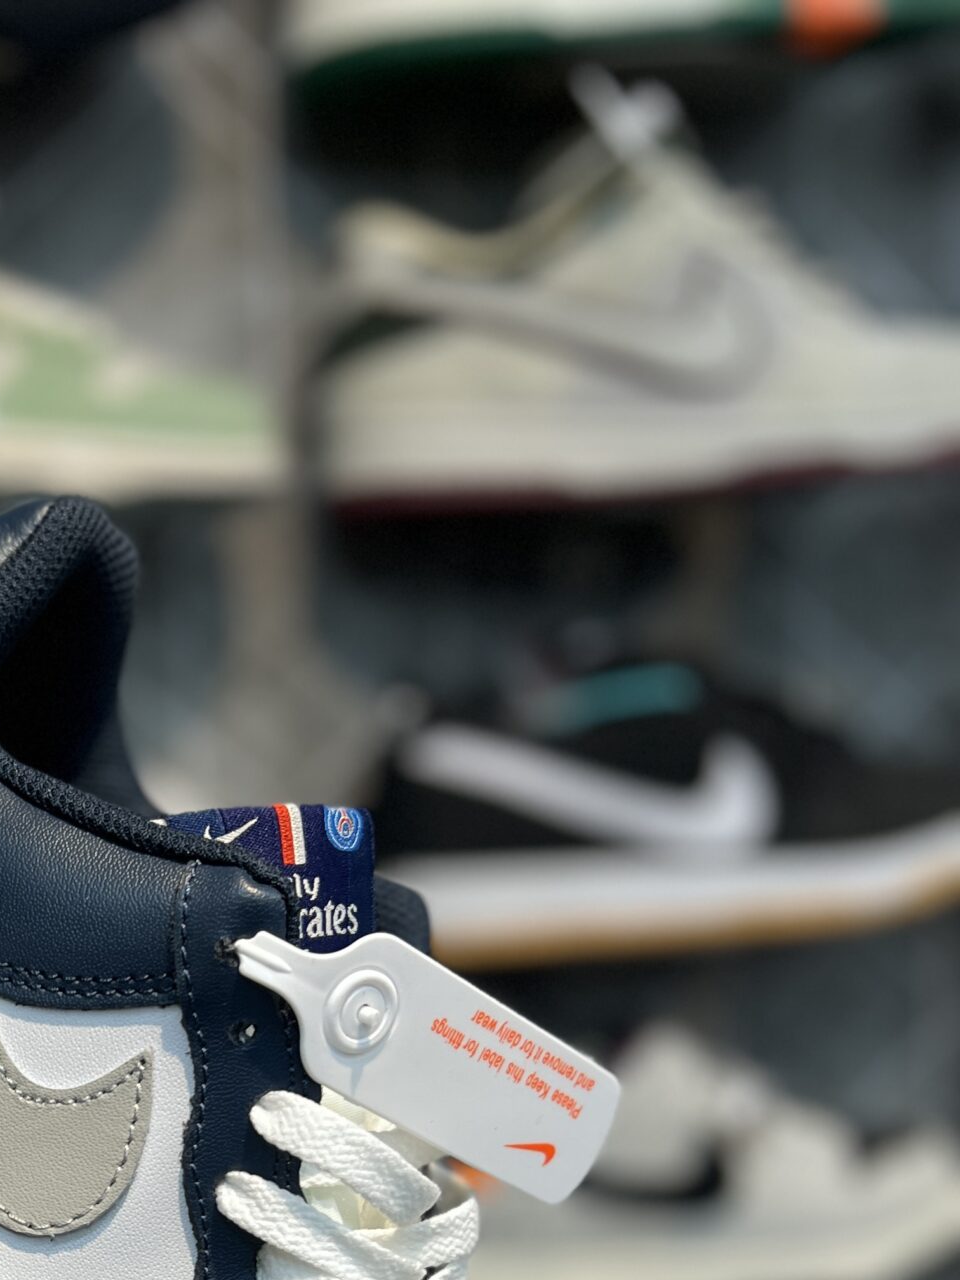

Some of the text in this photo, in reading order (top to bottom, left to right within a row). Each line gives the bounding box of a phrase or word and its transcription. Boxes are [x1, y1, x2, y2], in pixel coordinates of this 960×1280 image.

[289, 873, 320, 900] ly
[431, 1017, 583, 1120] Please Keep this label for fittings
[471, 1009, 596, 1091] and remove it for daily wear
